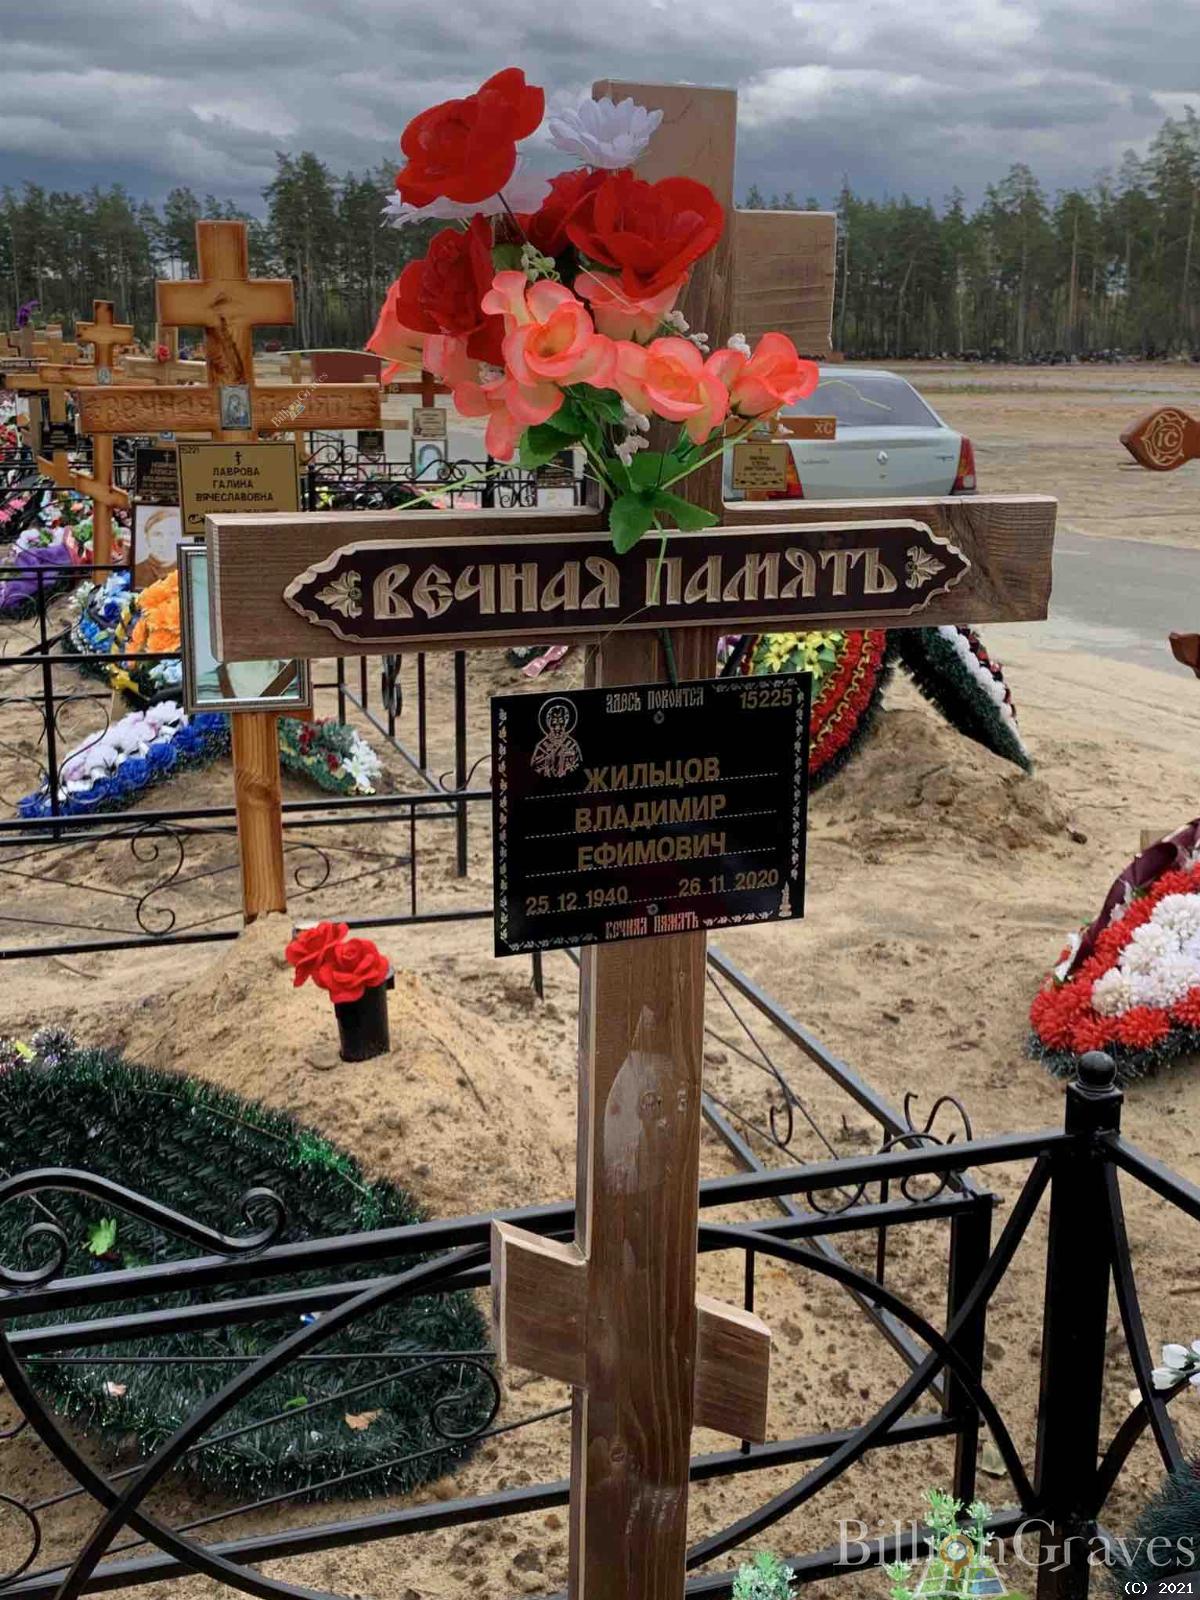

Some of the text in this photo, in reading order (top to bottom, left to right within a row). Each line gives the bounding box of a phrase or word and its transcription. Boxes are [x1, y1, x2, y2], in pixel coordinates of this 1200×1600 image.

[212, 467, 261, 476] ЛАВРОВА
[195, 492, 274, 502] ВЯЧЕСЛАВОВНА
[212, 480, 254, 489] ГАЛИНА
[373, 547, 898, 620] ВЕЧНАЯ ПАМЯТЬ
[647, 686, 704, 711] ПОКОИТСЯ
[739, 688, 793, 710] 15225
[584, 756, 721, 792] ЖИЛЬЦОВ
[574, 793, 727, 834] ВЛАДИМИР
[577, 831, 727, 872] ЕФИМОВИЧ
